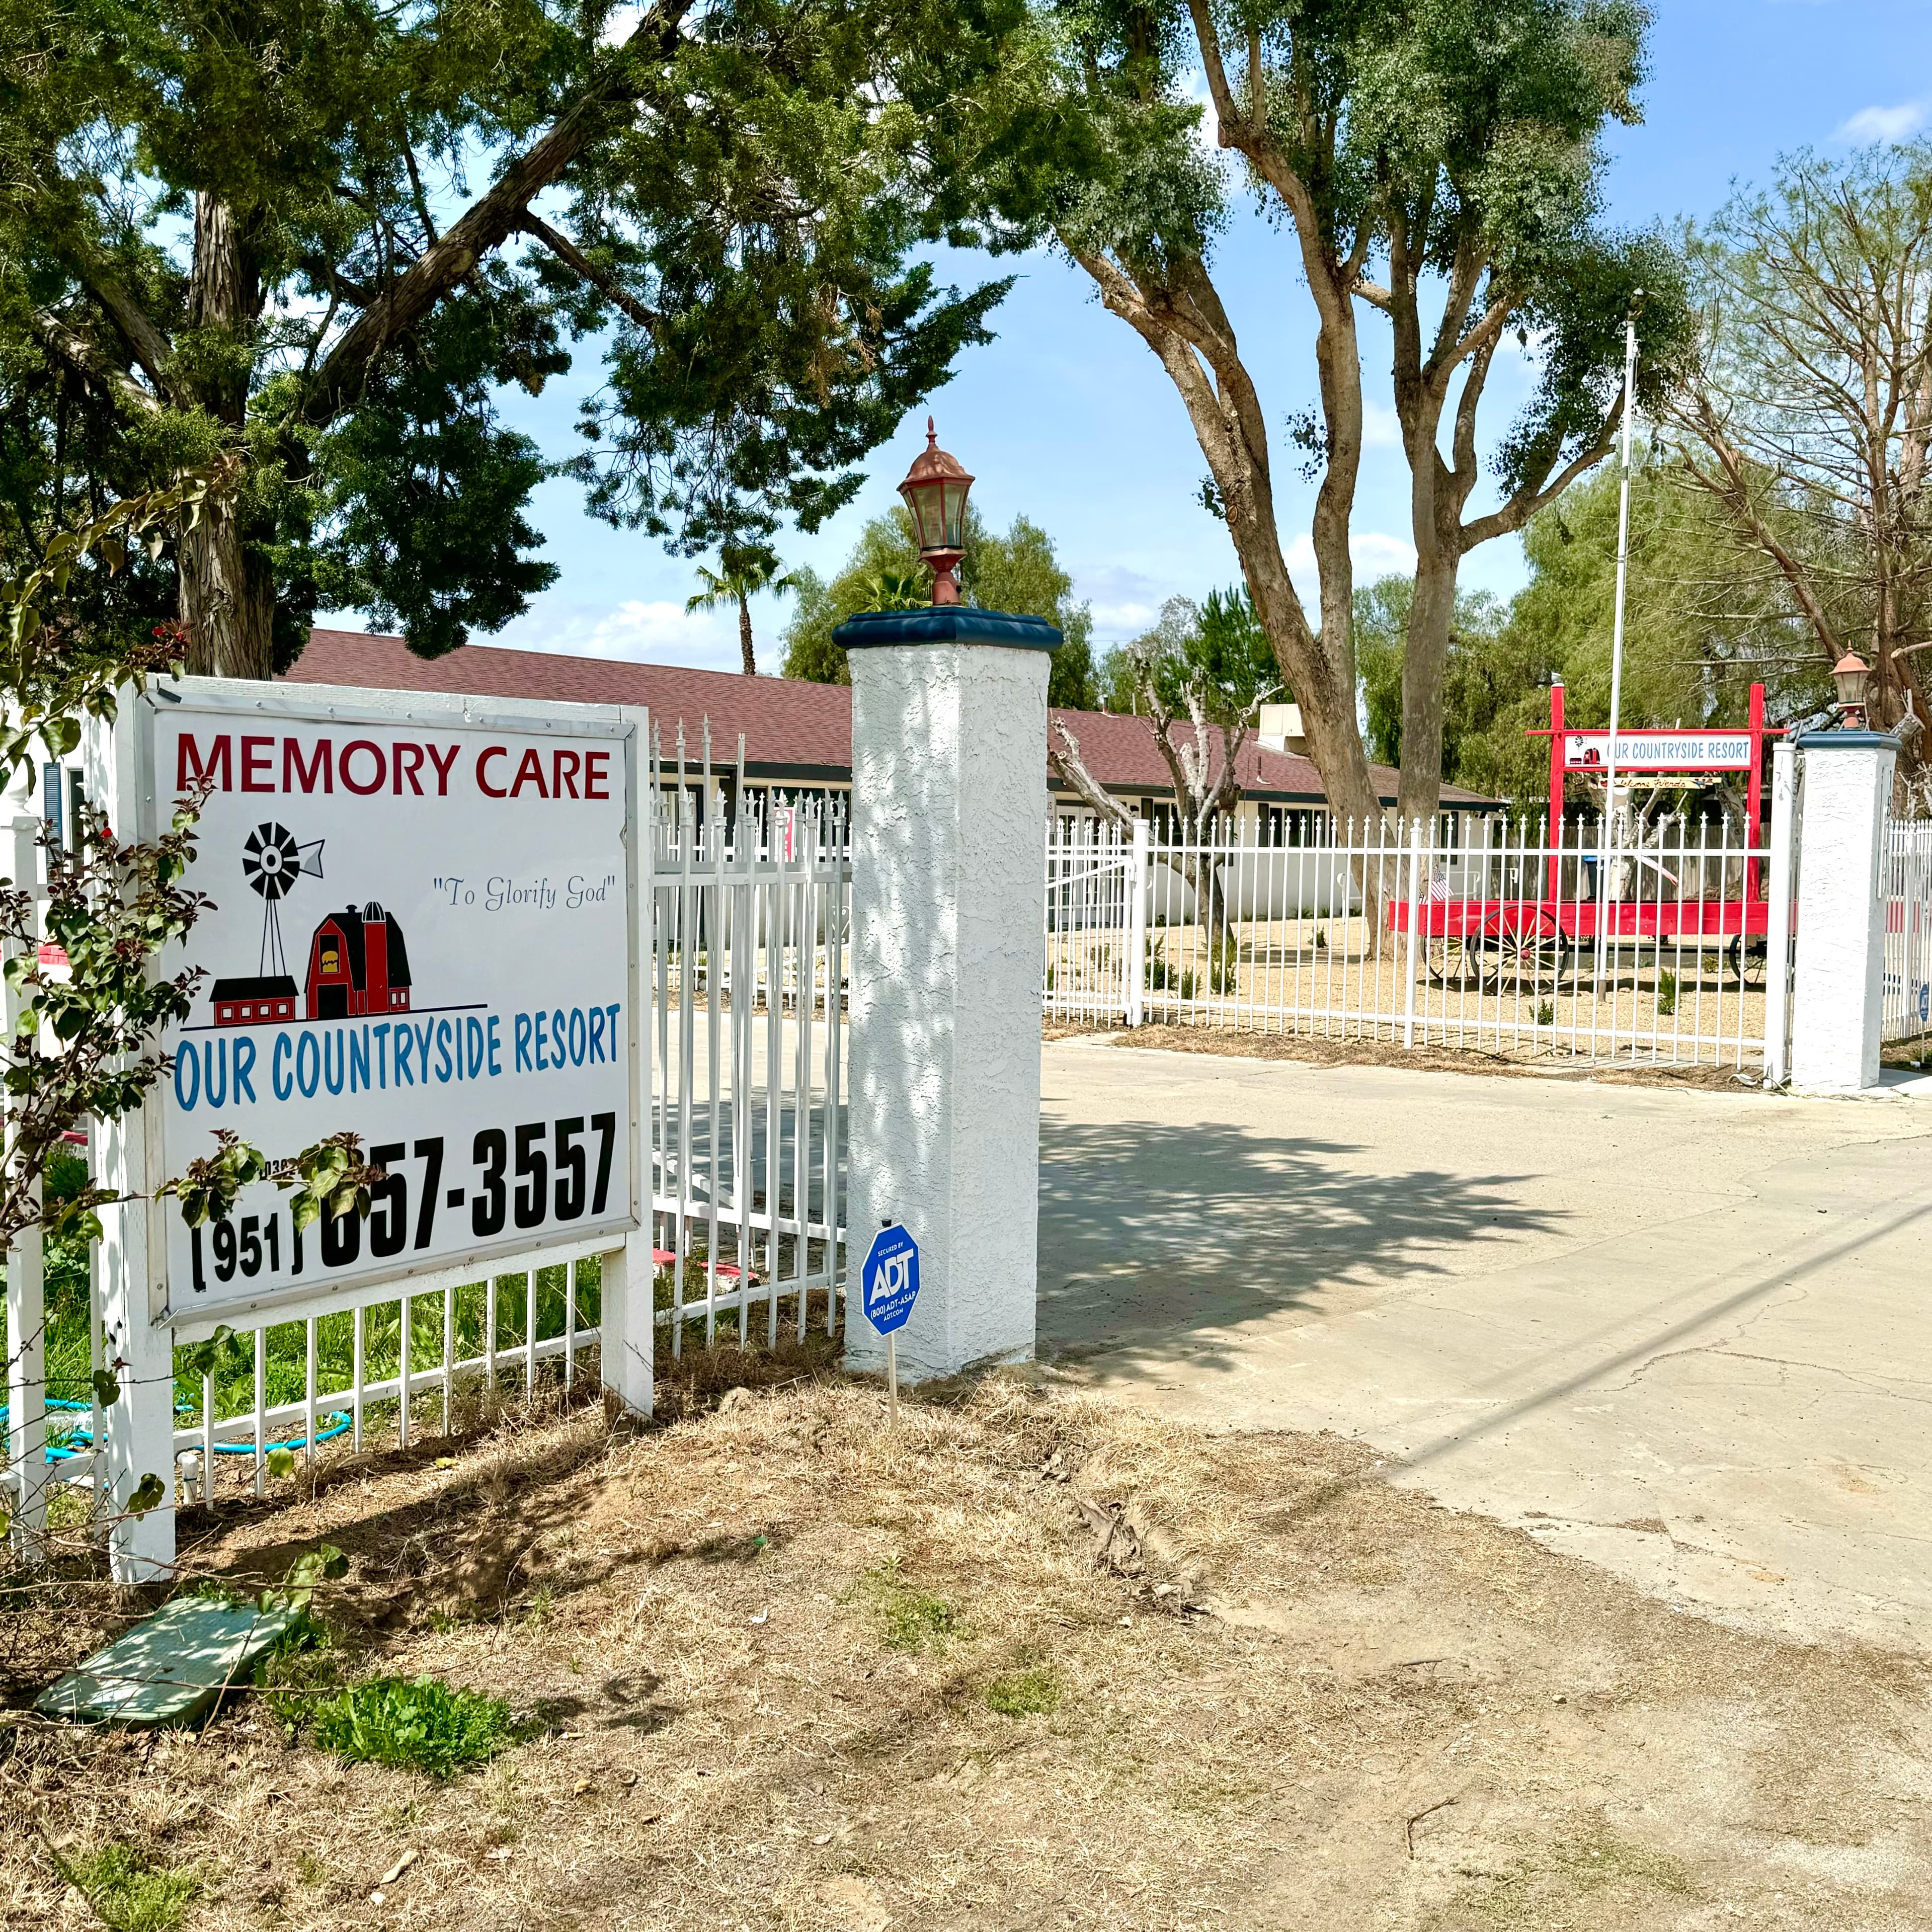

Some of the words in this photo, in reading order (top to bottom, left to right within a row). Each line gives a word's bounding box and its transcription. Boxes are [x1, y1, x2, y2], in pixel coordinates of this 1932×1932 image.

[177, 733, 461, 796] MEMORY
[475, 746, 610, 800] CARE
[1633, 742, 1704, 759] COUNTRYSIDE
[1708, 742, 1749, 759] RESORT
[433, 877, 475, 907] "To
[485, 877, 556, 912] Glorify
[567, 875, 615, 910] God"
[174, 1036, 257, 1111] OUR
[273, 1015, 502, 1101] COUNTRYSIDE
[515, 1003, 621, 1074] RESORT
[320, 1111, 616, 1268] 657-3557
[877, 1244, 898, 1257] SECURED
[869, 1248, 914, 1306] ADT
[870, 1304, 886, 1320] (800)
[886, 1291, 916, 1311] ADT-ASAP
[883, 1307, 904, 1322] ADT.COM
